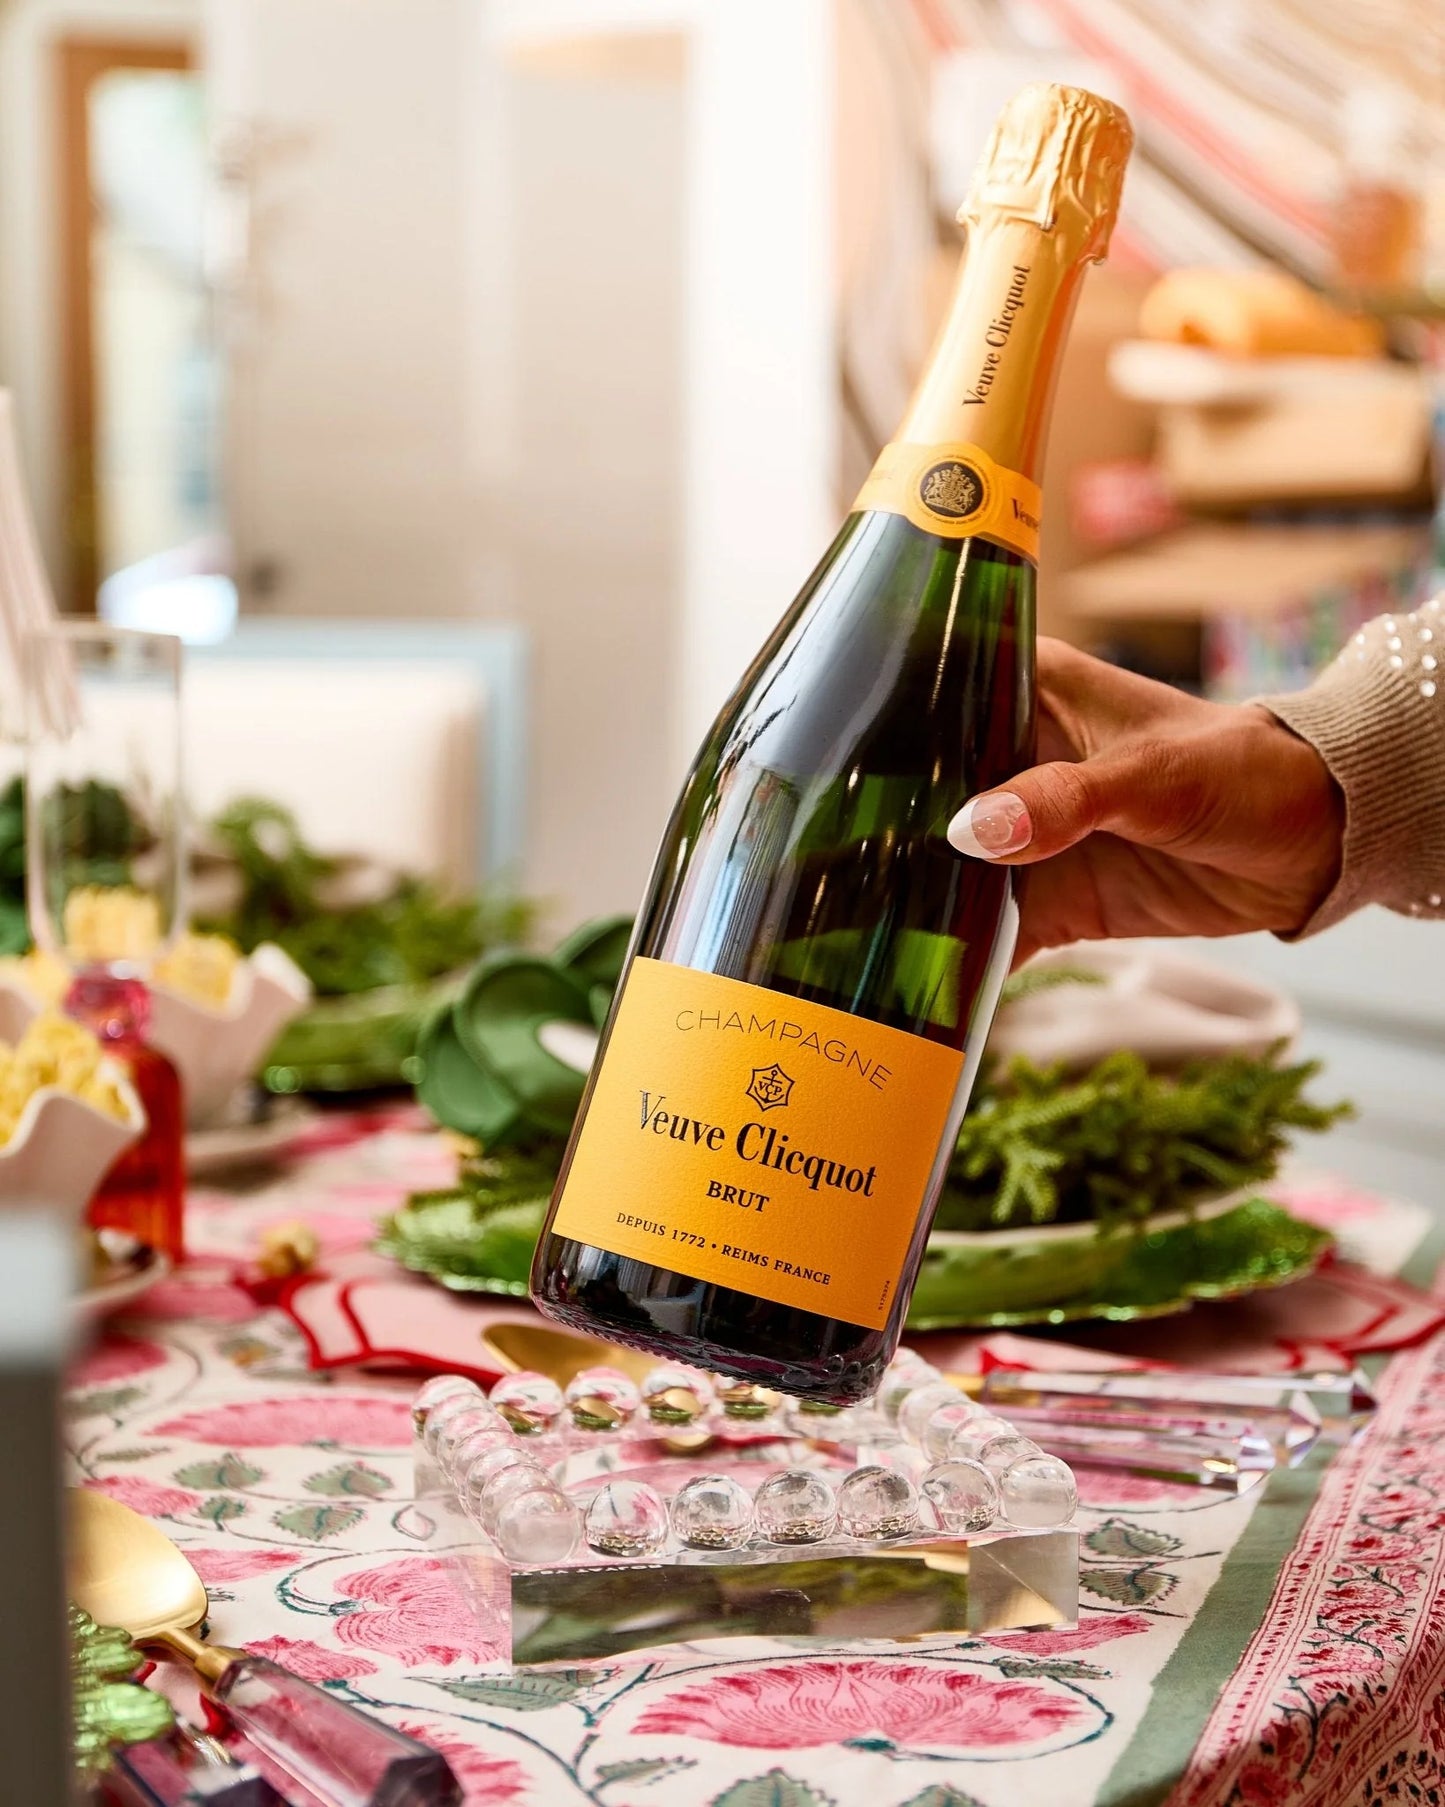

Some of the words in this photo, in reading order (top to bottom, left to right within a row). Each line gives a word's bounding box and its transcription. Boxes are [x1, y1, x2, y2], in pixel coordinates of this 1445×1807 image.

[962, 353, 1000, 406] Veuve
[985, 265, 1031, 347] Clicquot
[675, 1010, 893, 1090] CHAMPAGNE
[758, 1080, 782, 1095] VCP
[639, 1090, 725, 1151] Veuve
[736, 1122, 877, 1197] Clicquot
[706, 1180, 770, 1212] BRUT
[616, 1212, 666, 1236] DEPUIS
[671, 1229, 705, 1248] 1772
[721, 1244, 769, 1267] REIMS
[773, 1259, 831, 1285] FRANCE
